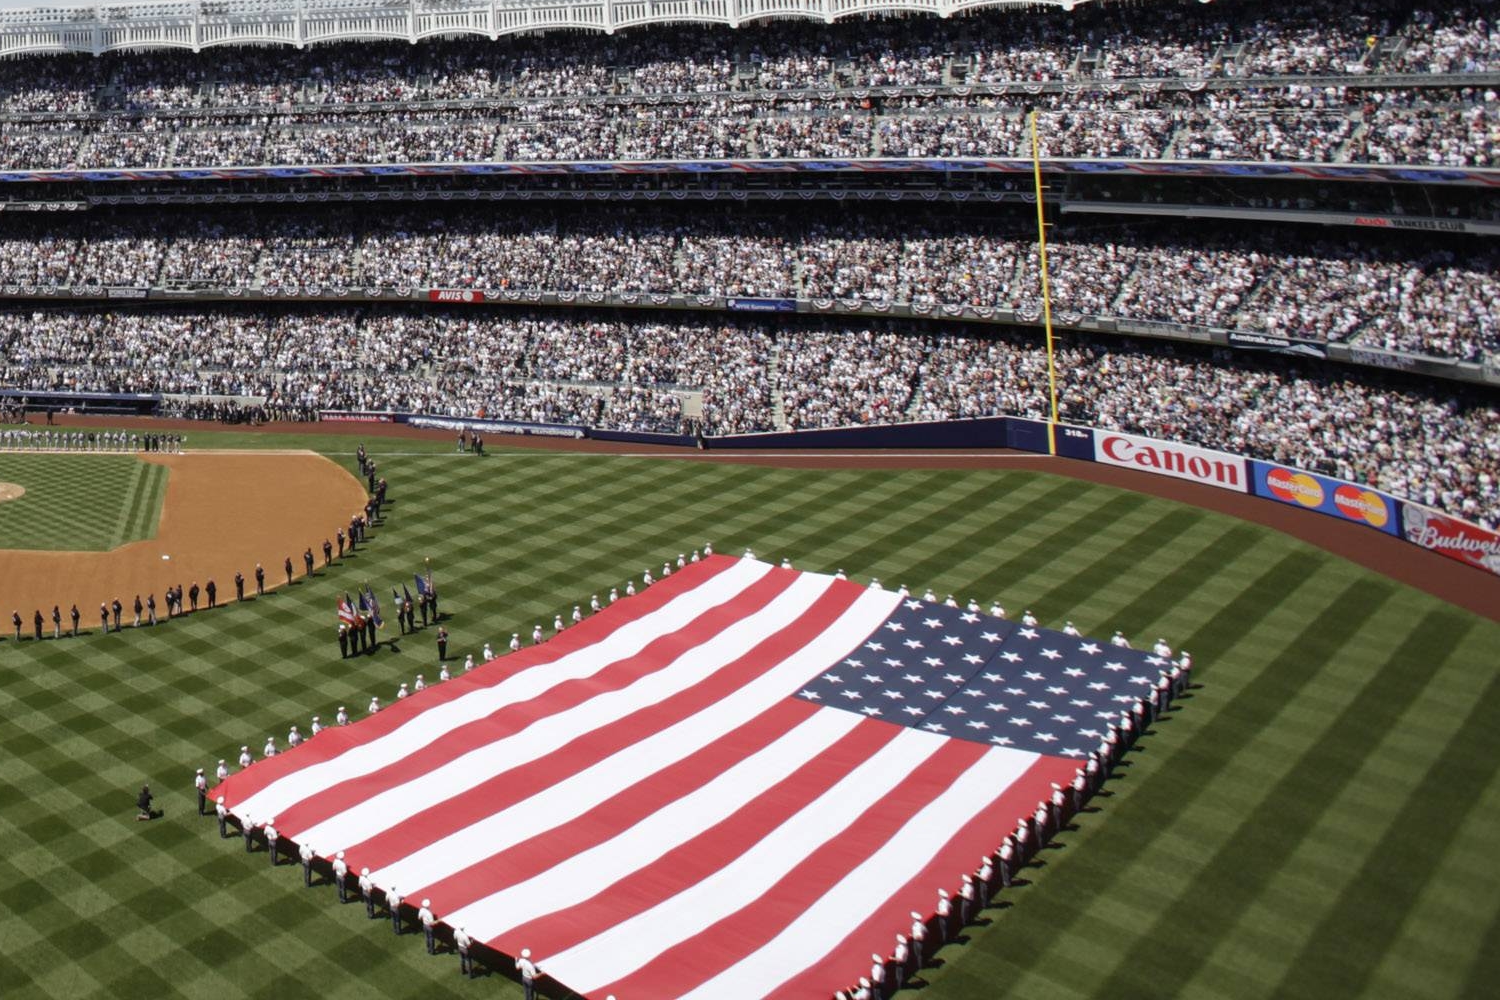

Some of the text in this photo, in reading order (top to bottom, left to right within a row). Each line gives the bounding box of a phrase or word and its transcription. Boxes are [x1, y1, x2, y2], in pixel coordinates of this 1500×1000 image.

[1392, 218, 1437, 229] YANKEES
[1438, 222, 1466, 231] CLUB
[438, 291, 462, 301] AVIS
[1230, 333, 1290, 347] Amtrak.com
[1102, 436, 1238, 485] Canon
[1267, 476, 1321, 498] MasterCard
[1410, 526, 1500, 553] Budwei
